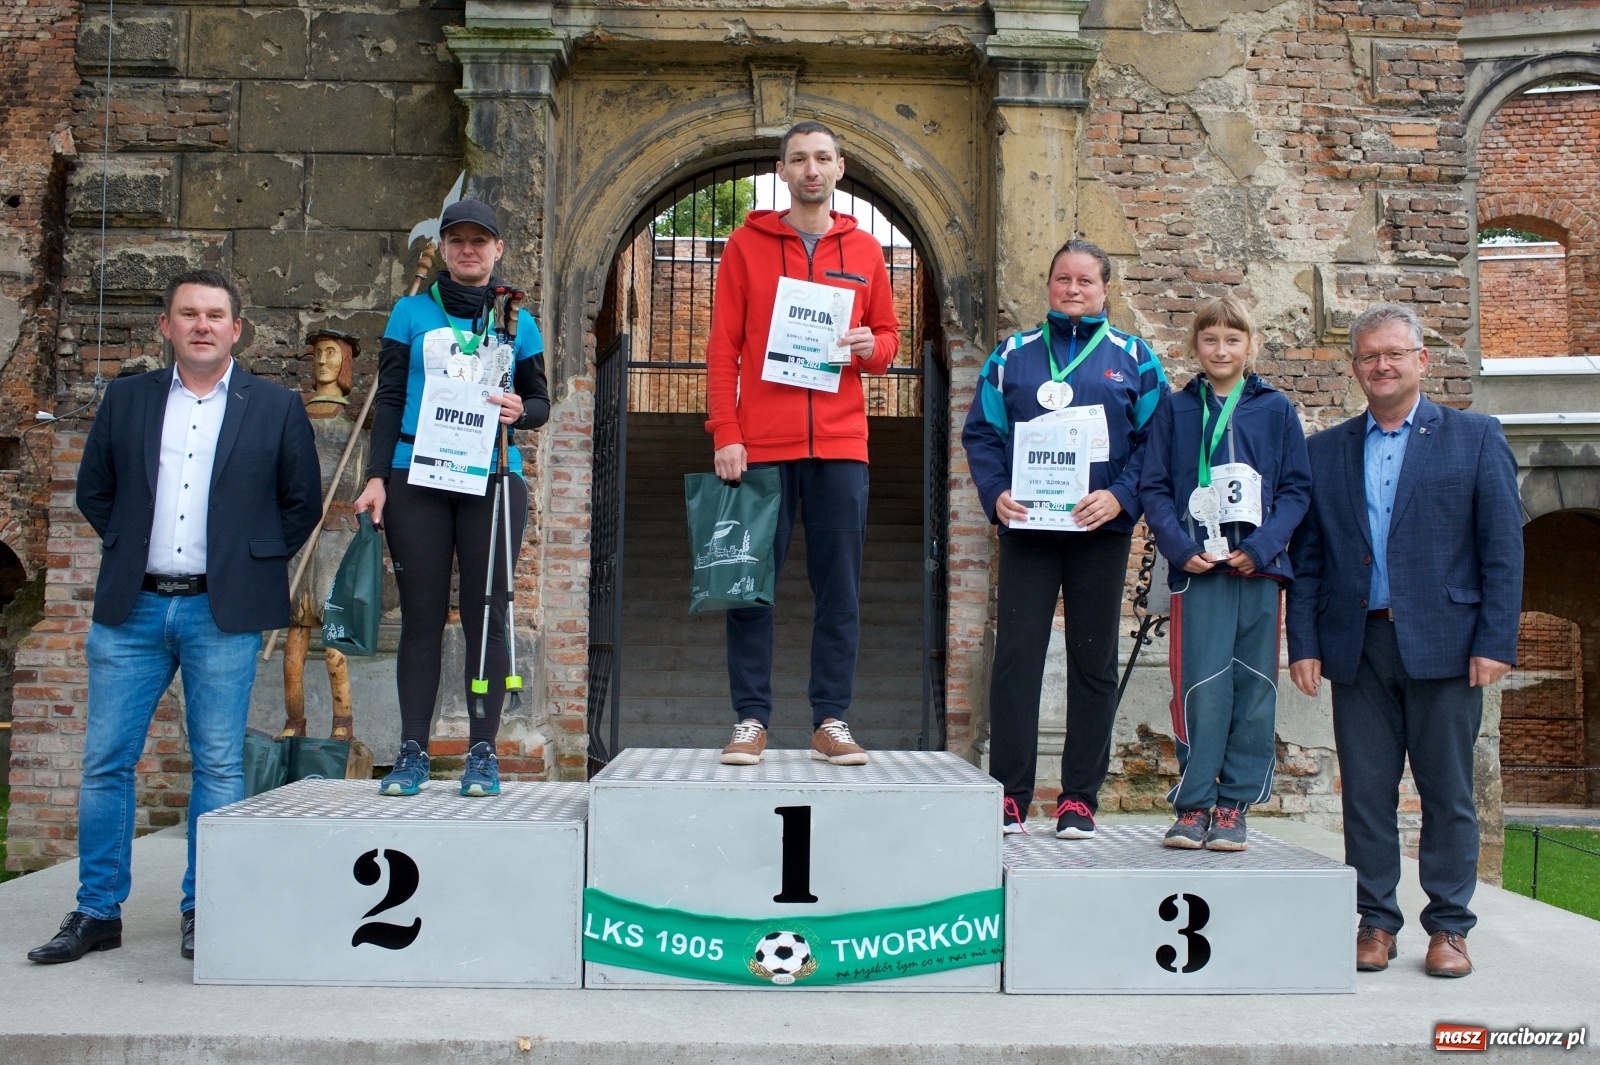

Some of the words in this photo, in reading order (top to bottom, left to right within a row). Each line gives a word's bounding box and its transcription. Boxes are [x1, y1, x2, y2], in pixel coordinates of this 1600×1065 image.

[787, 356, 821, 369] 19.09.2021
[435, 407, 485, 428] DYPLOM
[434, 459, 468, 473] 19.09.2021
[1028, 451, 1076, 465] DYPLOM
[1227, 480, 1243, 504] 3
[1033, 502, 1067, 511] 19.09.2021
[773, 805, 819, 904] 1
[351, 848, 422, 950] 2
[584, 912, 644, 948] LKS
[656, 930, 724, 961] 1905
[831, 913, 1000, 962] TWORKÓW
[1155, 893, 1211, 974] 3
